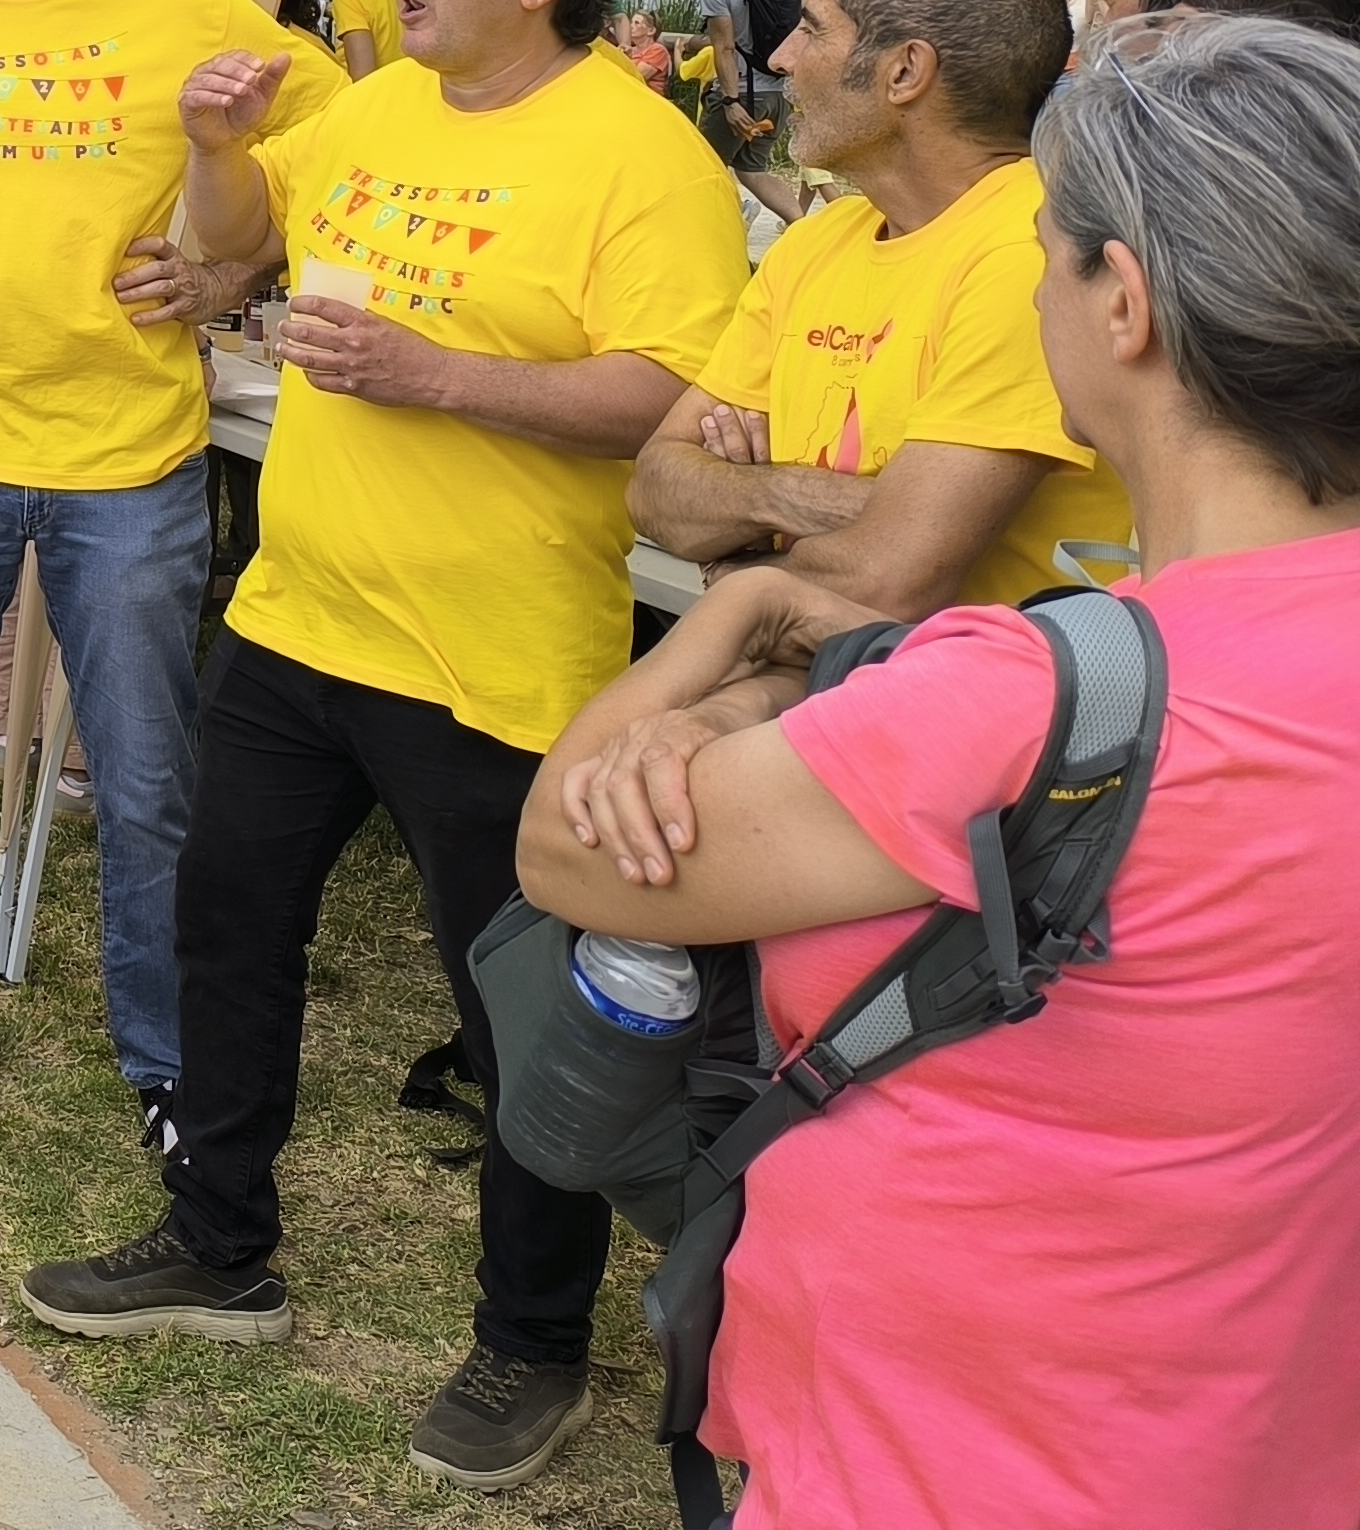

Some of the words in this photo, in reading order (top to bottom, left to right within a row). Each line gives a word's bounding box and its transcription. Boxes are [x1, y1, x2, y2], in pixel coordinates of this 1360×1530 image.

[31, 145, 60, 160] UN
[75, 141, 118, 160] POC
[349, 168, 512, 203] BRESSOLADA
[310, 212, 329, 234] DE
[370, 286, 399, 306] UN
[408, 293, 454, 315] POC
